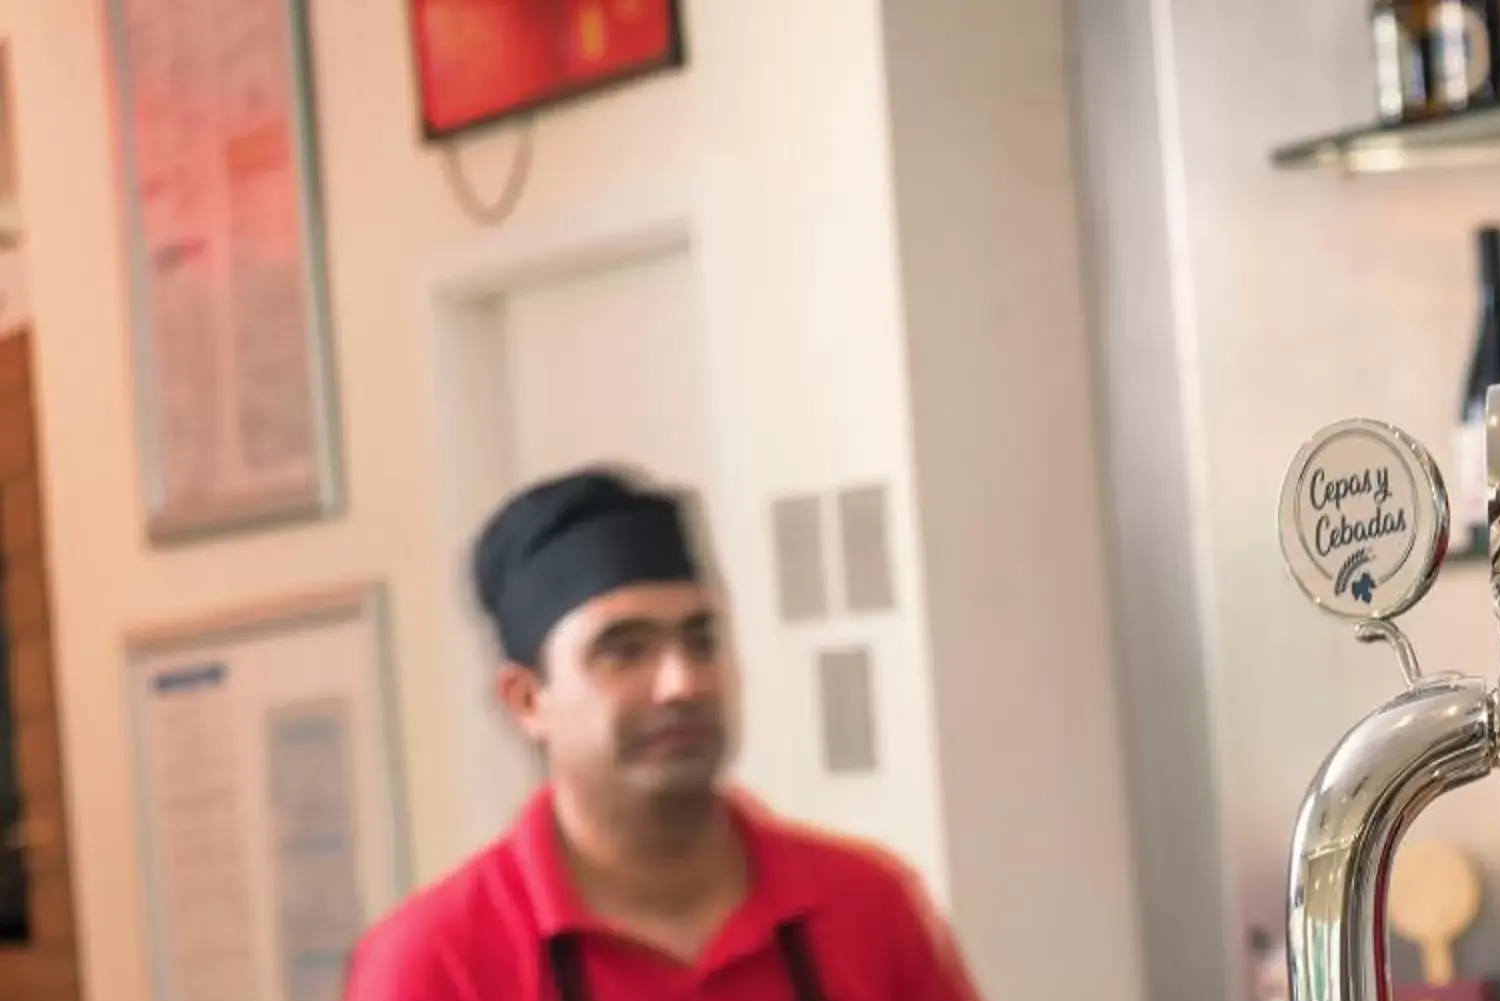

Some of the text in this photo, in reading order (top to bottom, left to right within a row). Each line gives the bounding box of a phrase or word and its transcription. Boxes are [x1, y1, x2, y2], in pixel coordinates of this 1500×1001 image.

[1310, 467, 1393, 511] Cepas y
[1316, 508, 1406, 557] Cebadas
